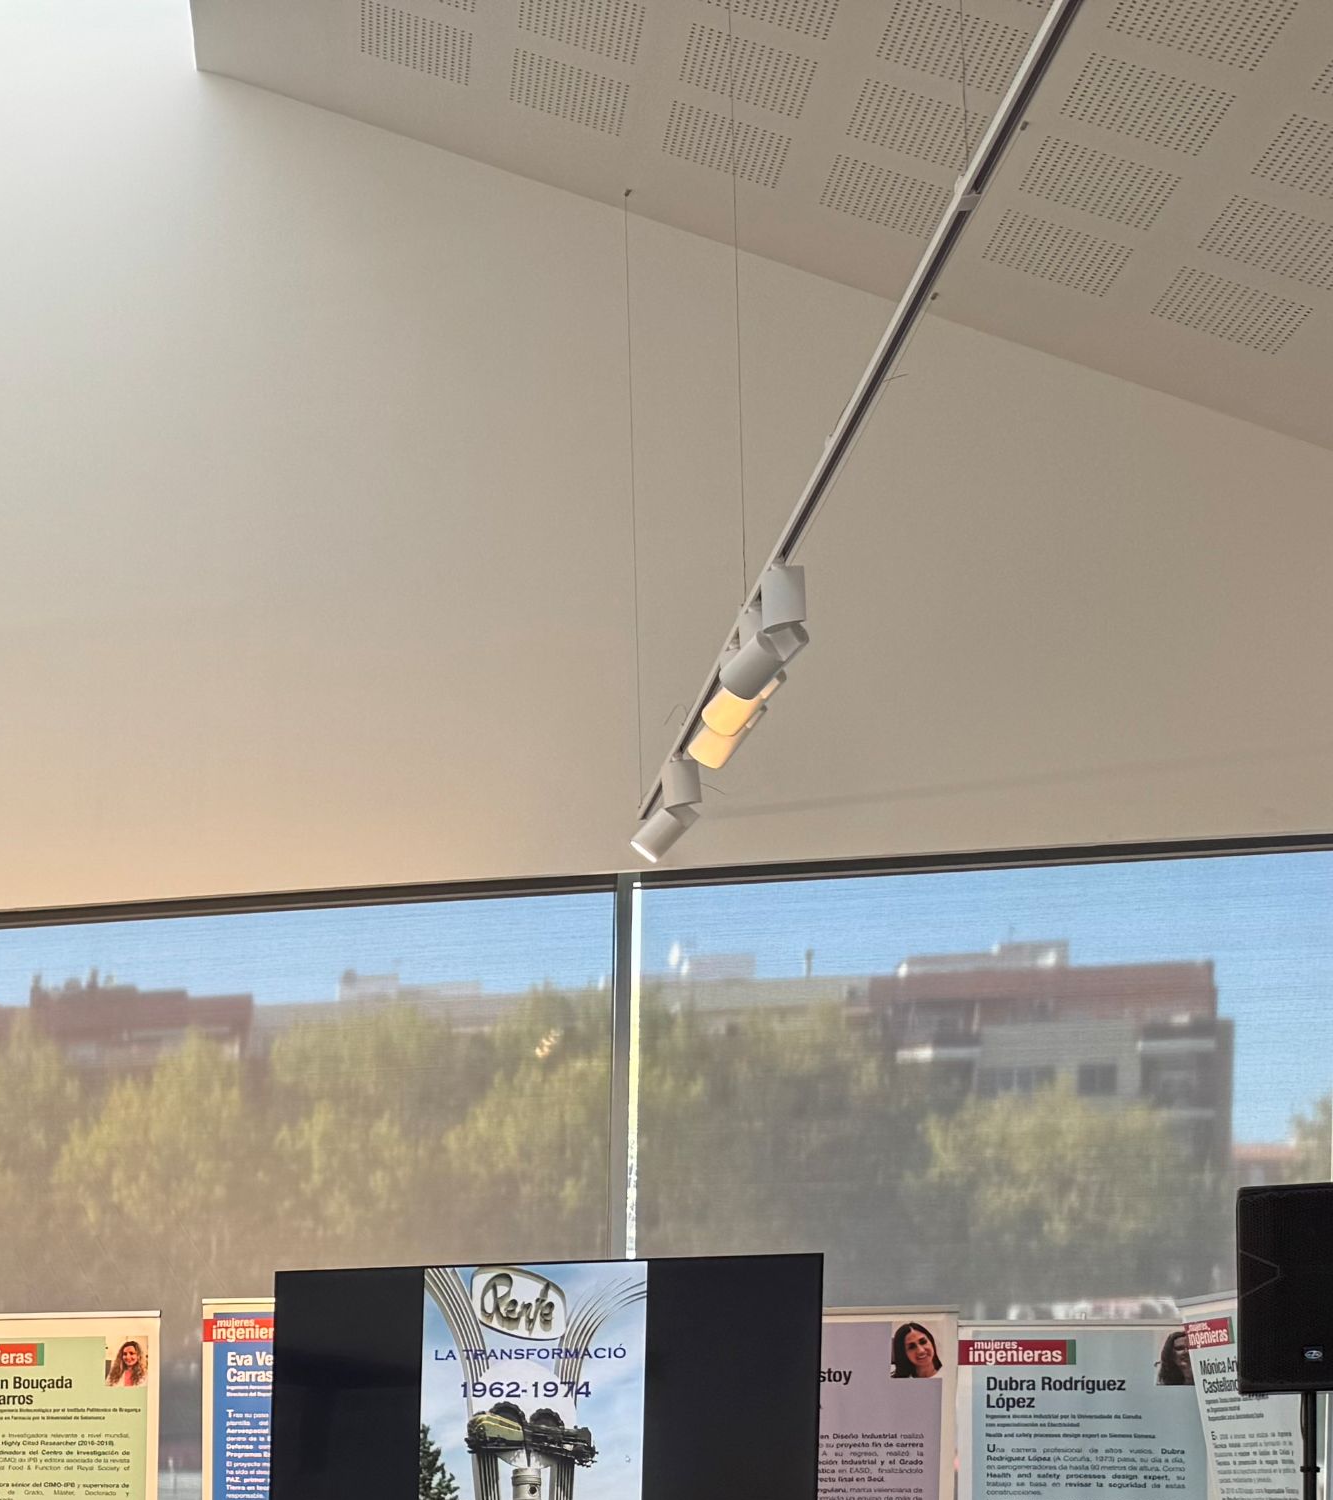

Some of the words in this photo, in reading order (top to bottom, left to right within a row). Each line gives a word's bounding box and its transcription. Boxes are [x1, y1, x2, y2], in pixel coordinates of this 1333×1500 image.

[481, 1273, 555, 1332] Renfe
[217, 1319, 255, 1328] mujeres
[975, 1341, 1017, 1350] mujeres
[1188, 1329, 1228, 1348] ingenieras
[228, 1352, 252, 1365] Eva
[435, 1350, 456, 1360] LA
[463, 1344, 626, 1360] TRANSFORMACIÓ
[969, 1347, 1062, 1365] ingenieras
[1200, 1358, 1226, 1375] Mónica
[13, 1376, 72, 1392] Bouçada
[461, 1381, 591, 1398] 1962-1974
[986, 1377, 1036, 1390] Dubra
[1042, 1375, 1125, 1394] Rodríguez
[986, 1393, 1035, 1411] López
[1037, 1472, 1060, 1480] safety
